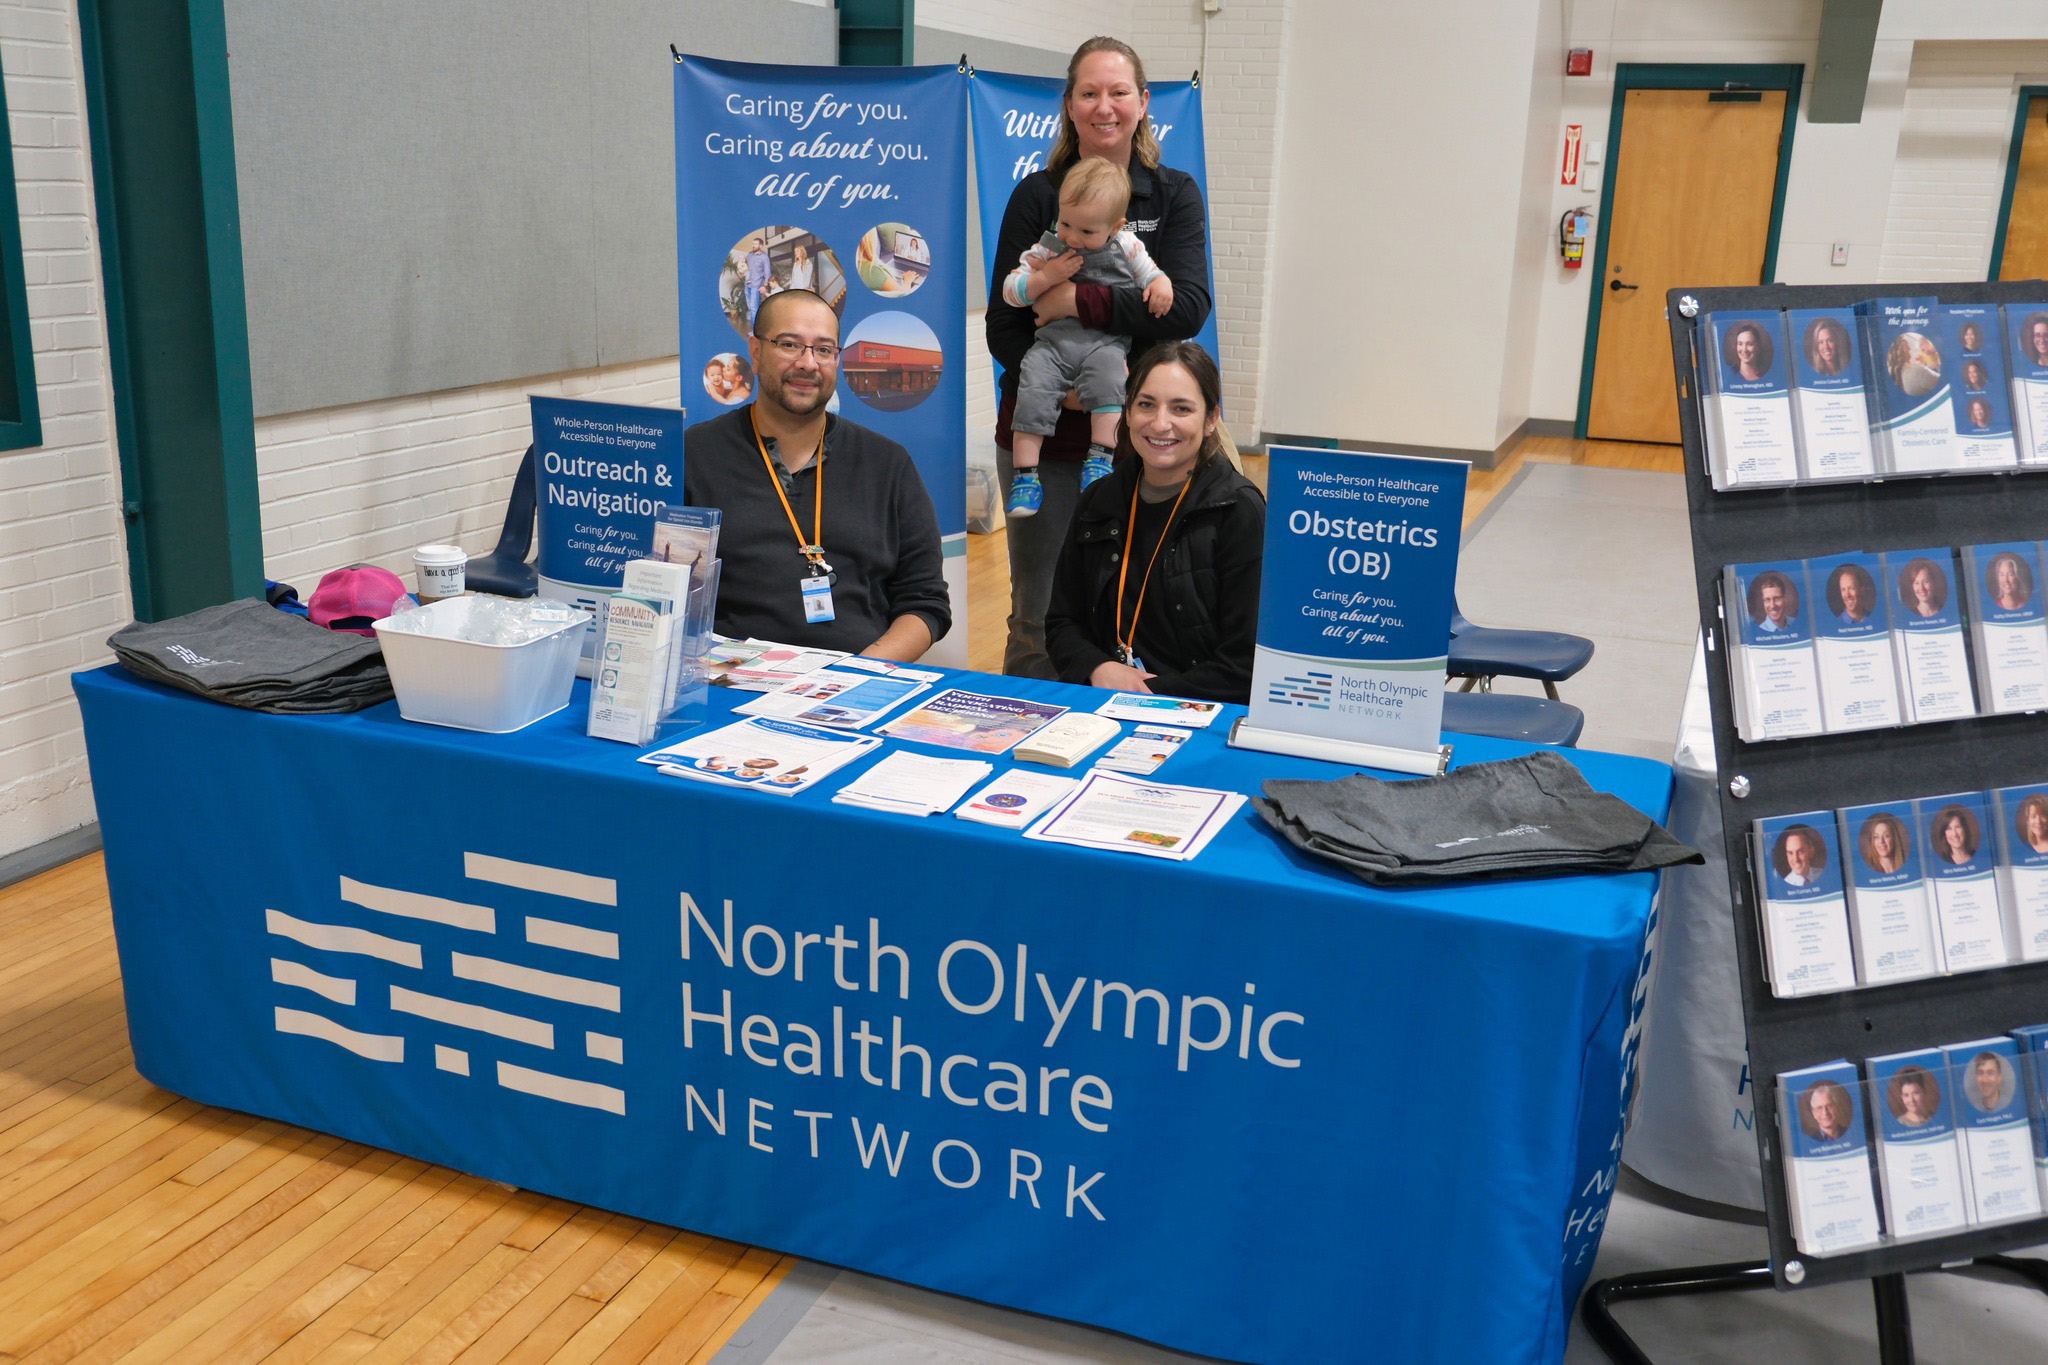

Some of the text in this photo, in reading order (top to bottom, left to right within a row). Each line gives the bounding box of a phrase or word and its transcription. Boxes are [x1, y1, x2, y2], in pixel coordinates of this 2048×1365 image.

[726, 93, 908, 131] Caring for you.
[705, 131, 929, 166] Caring about you.
[1012, 151, 1049, 181] th
[754, 172, 900, 211] All of you.
[553, 416, 663, 437] Whole-Person Healthcare
[560, 430, 656, 451] Accessible to Everyone
[544, 452, 673, 487] Outreach &
[1297, 470, 1439, 493] Whole-Person Healthcare
[548, 482, 666, 516] Navigation
[1304, 486, 1430, 508] Accessible to Everyone
[574, 523, 638, 542] Caring for you.
[1289, 510, 1438, 548] Obstetrics
[567, 538, 596, 553] Caring
[596, 541, 626, 556] about
[584, 556, 626, 574] All of yo
[1328, 546, 1391, 580] (OB)
[1312, 588, 1396, 609] Caring for you.
[611, 606, 656, 622] COMMUNITY
[1302, 606, 1404, 628] Caring about you.
[1322, 626, 1390, 645] All of you.
[951, 690, 992, 702] YOUTH
[1341, 676, 1428, 698] North Olympic
[934, 700, 989, 713] RADICAL
[942, 696, 1026, 713] ADVOCATING
[1340, 689, 1404, 708] Healthcare
[927, 704, 997, 719] DECISIONS
[1338, 704, 1402, 720] NETWORK
[680, 891, 1305, 1072] North Olympic
[682, 982, 1114, 1133] Healthcare
[684, 1083, 1107, 1221] NETWORK
